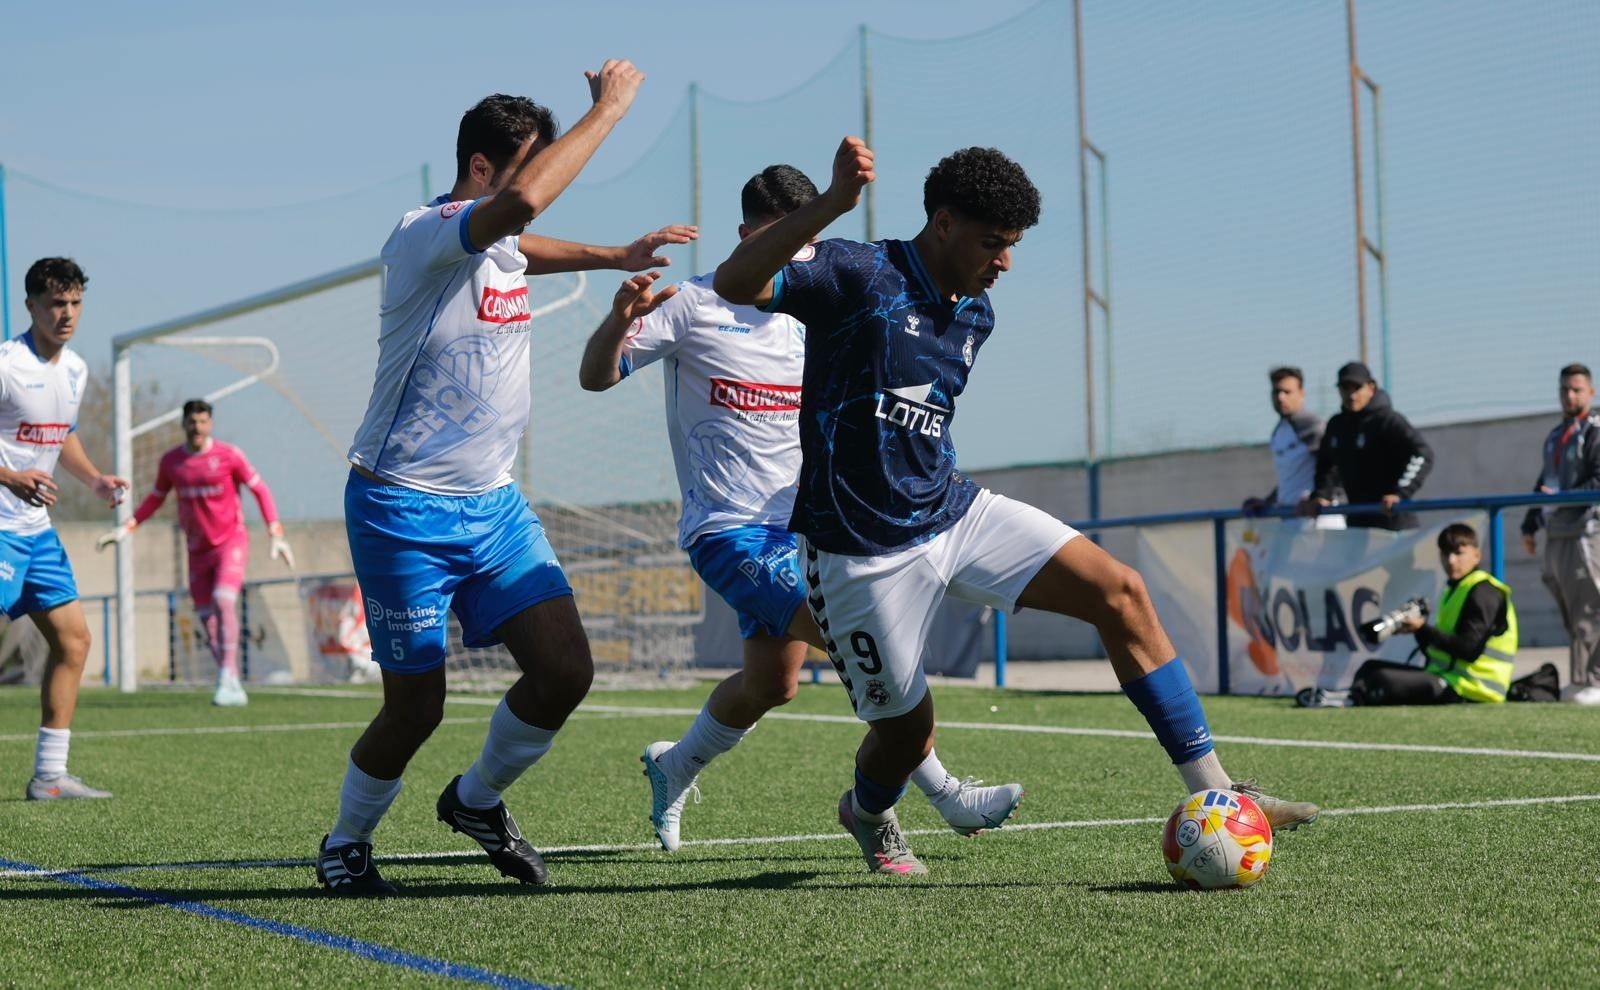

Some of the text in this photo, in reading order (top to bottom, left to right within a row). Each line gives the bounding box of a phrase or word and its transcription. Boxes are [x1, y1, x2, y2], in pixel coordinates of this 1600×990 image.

[750, 411, 768, 424] café
[769, 411, 779, 421] de
[874, 393, 945, 438] LOTUS
[773, 566, 799, 592] 16
[385, 604, 437, 620] Parking
[387, 616, 437, 633] Imagen
[390, 638, 405, 662] 5
[850, 630, 883, 675] 9
